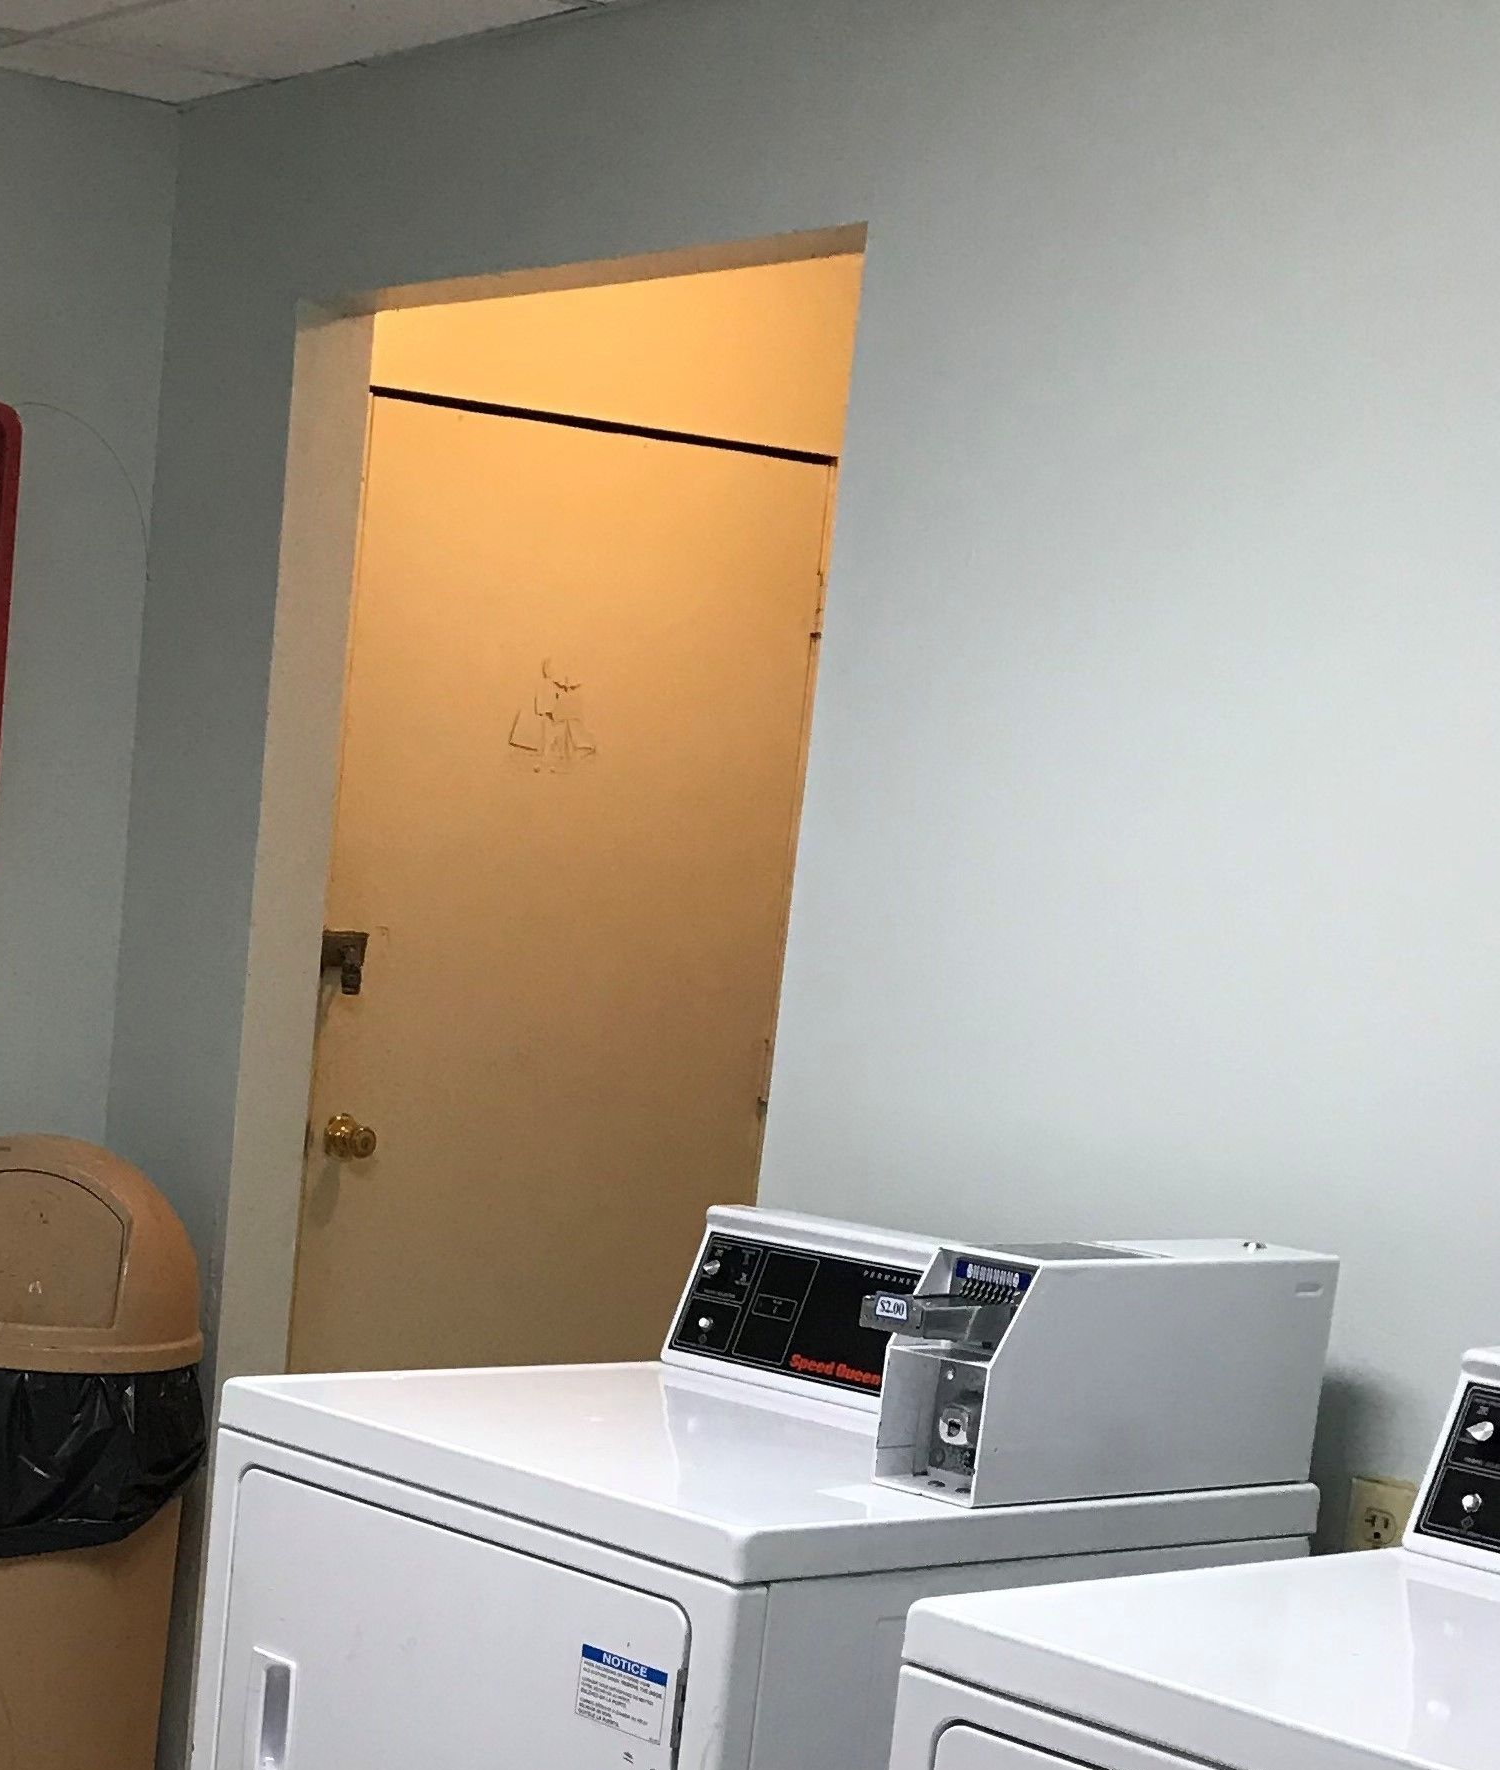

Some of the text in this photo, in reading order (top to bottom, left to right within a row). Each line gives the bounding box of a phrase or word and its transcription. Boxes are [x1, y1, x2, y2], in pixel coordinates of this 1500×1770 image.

[879, 1299, 905, 1317] $2.00
[789, 1353, 881, 1386] Speed Queen
[602, 1652, 648, 1678] NOTICE
